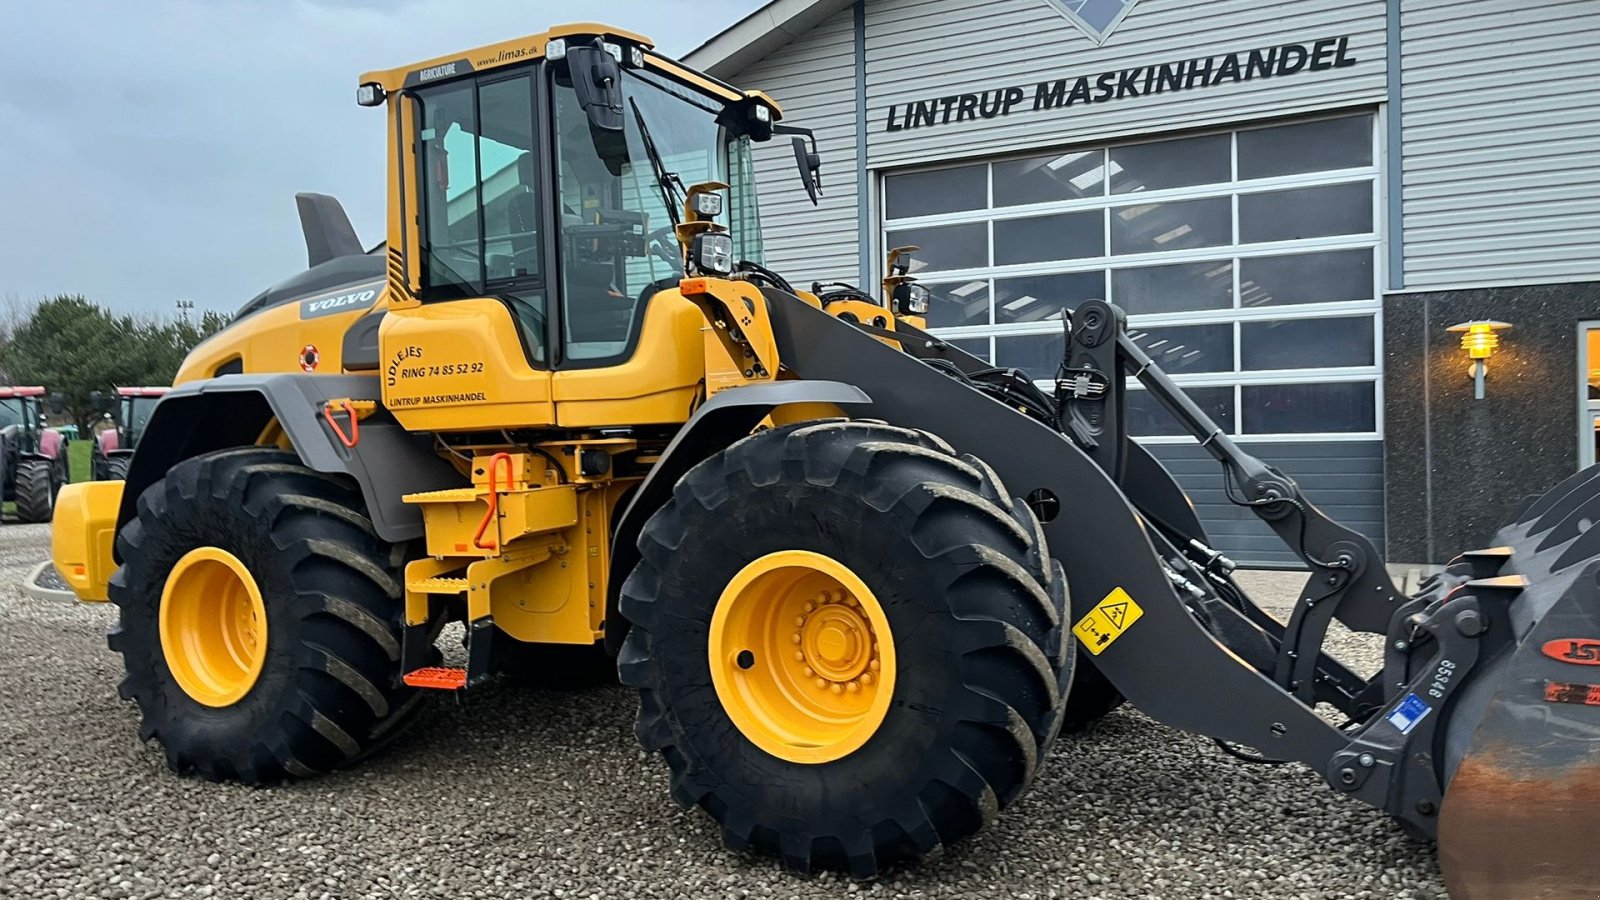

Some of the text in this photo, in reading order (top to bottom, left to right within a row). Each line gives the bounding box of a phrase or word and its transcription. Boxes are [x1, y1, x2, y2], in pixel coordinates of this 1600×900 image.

[477, 47, 537, 66] www.limas.dk
[419, 63, 456, 82] AGRICULTURE
[886, 37, 1356, 131] LINTRUP MASKINHANDEL
[309, 290, 375, 312] VOLVO
[388, 346, 422, 386] UDLEJES
[401, 362, 483, 379] RING 74 85 52 92
[389, 392, 486, 407] LINTRUP MASKINHANDEL
